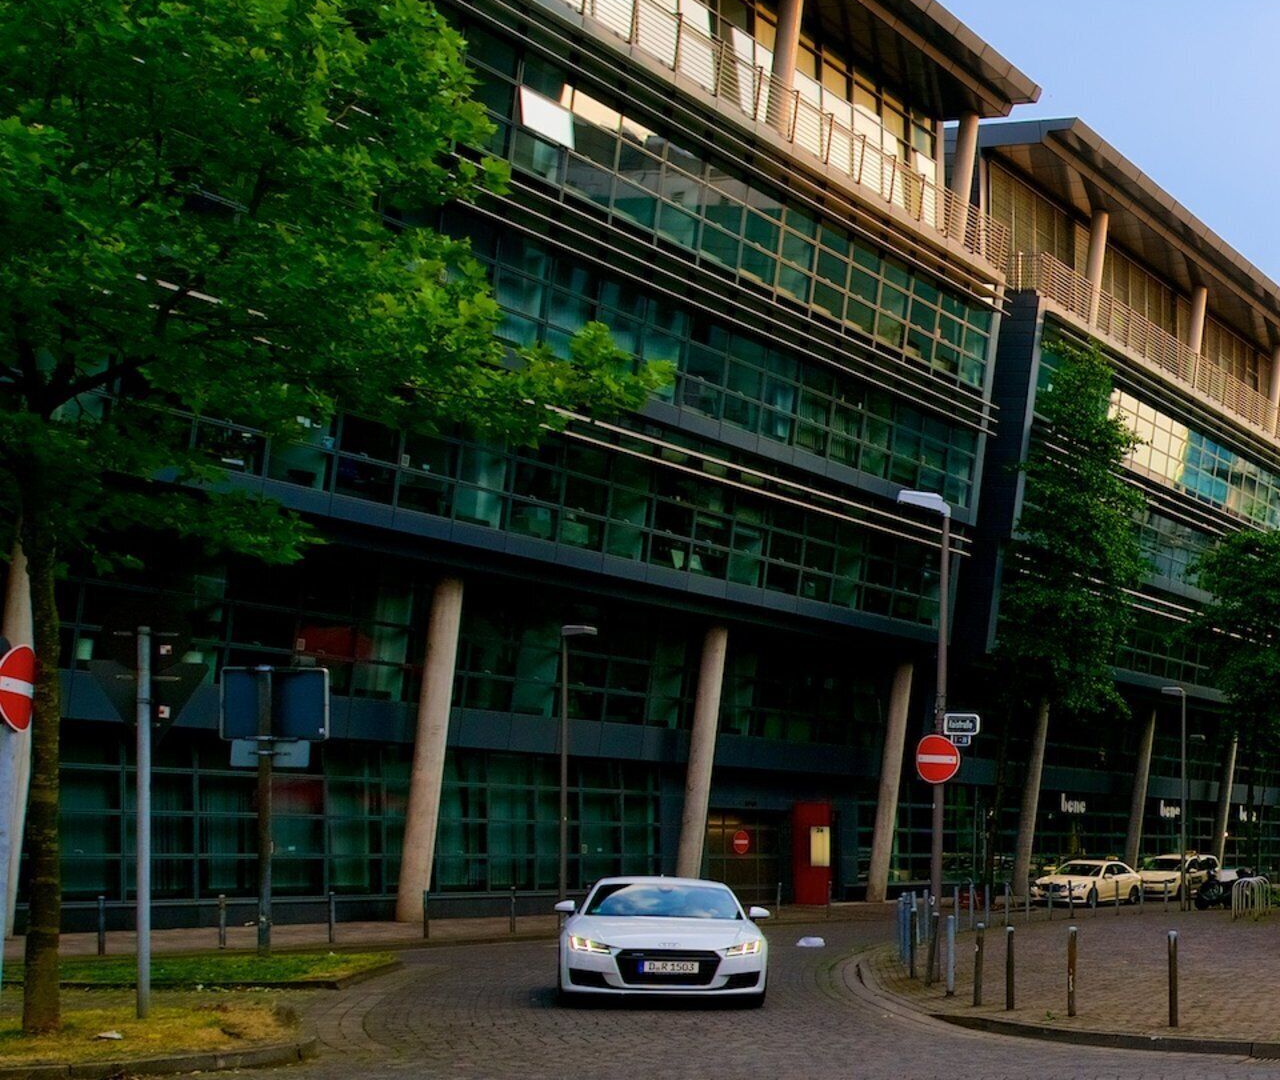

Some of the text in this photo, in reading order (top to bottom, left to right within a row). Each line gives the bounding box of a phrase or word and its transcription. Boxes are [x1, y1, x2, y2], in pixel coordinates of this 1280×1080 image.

[1061, 793, 1086, 814] bene
[1160, 800, 1181, 818] bene
[670, 963, 694, 972] 1503
